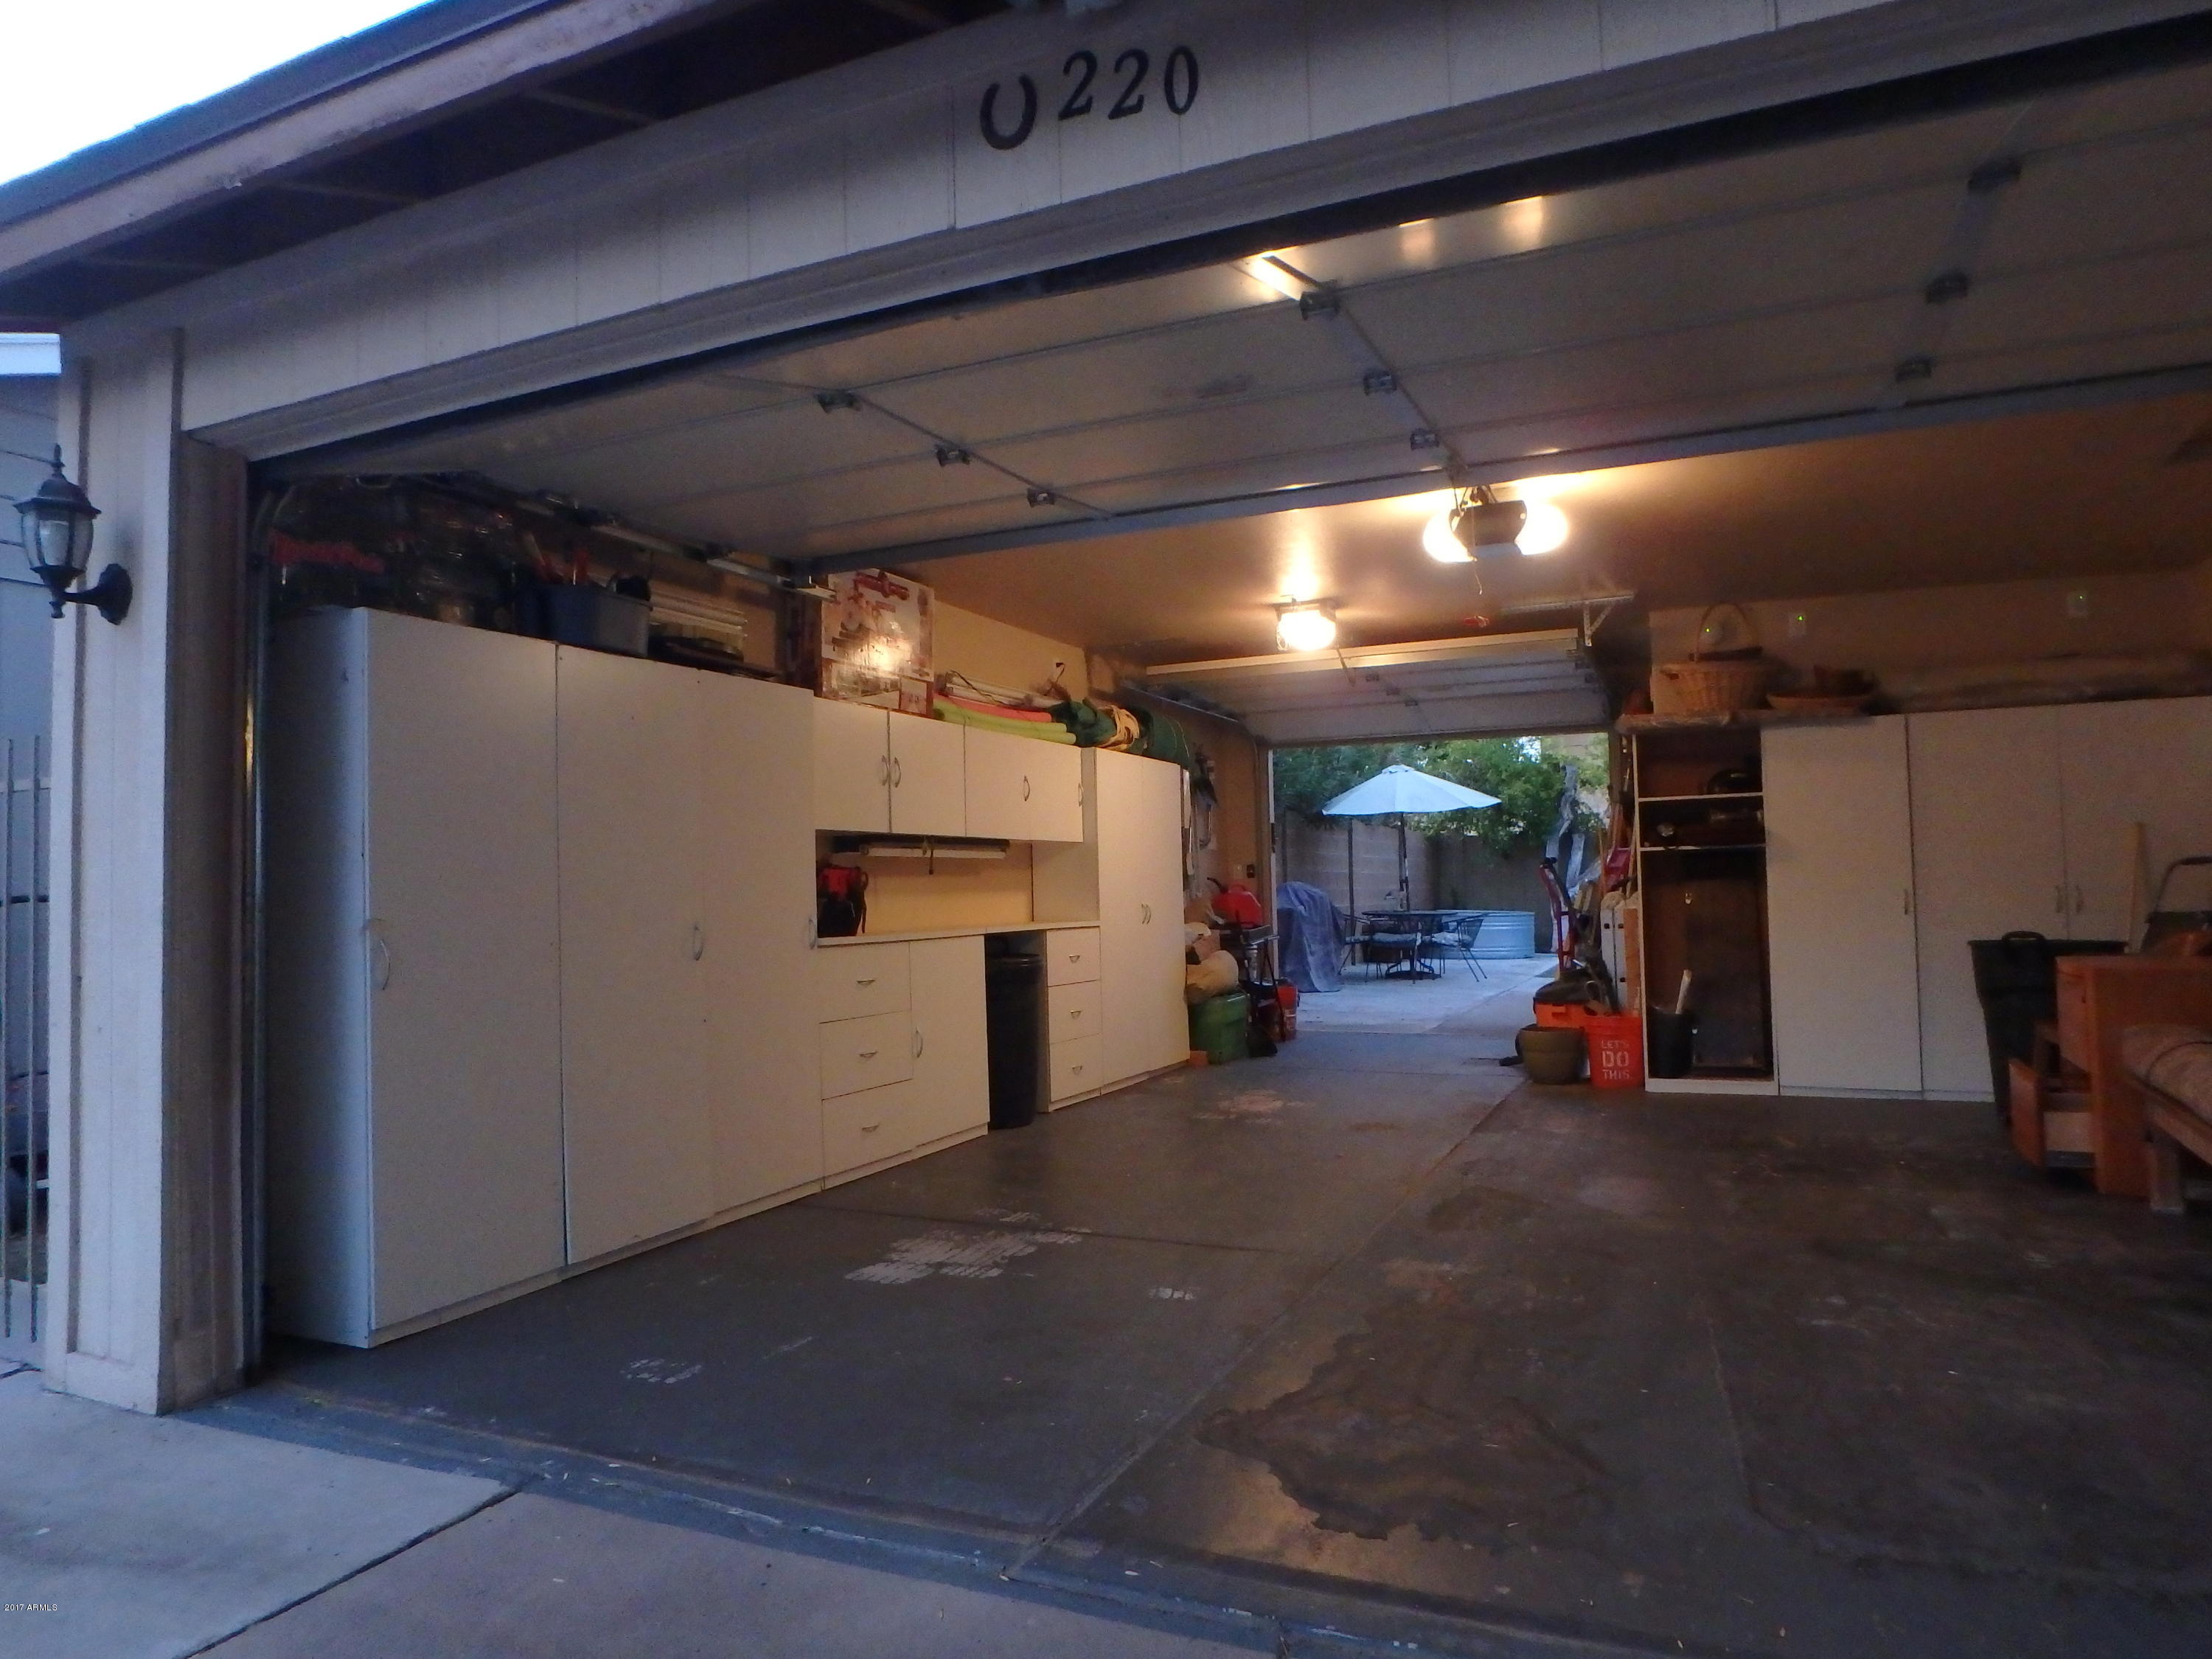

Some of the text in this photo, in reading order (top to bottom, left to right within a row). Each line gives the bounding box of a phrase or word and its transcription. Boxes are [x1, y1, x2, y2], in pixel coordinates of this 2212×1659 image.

[1058, 46, 1199, 120] 220
[1601, 1040, 1630, 1049] LET'S
[1601, 1051, 1630, 1068] DO
